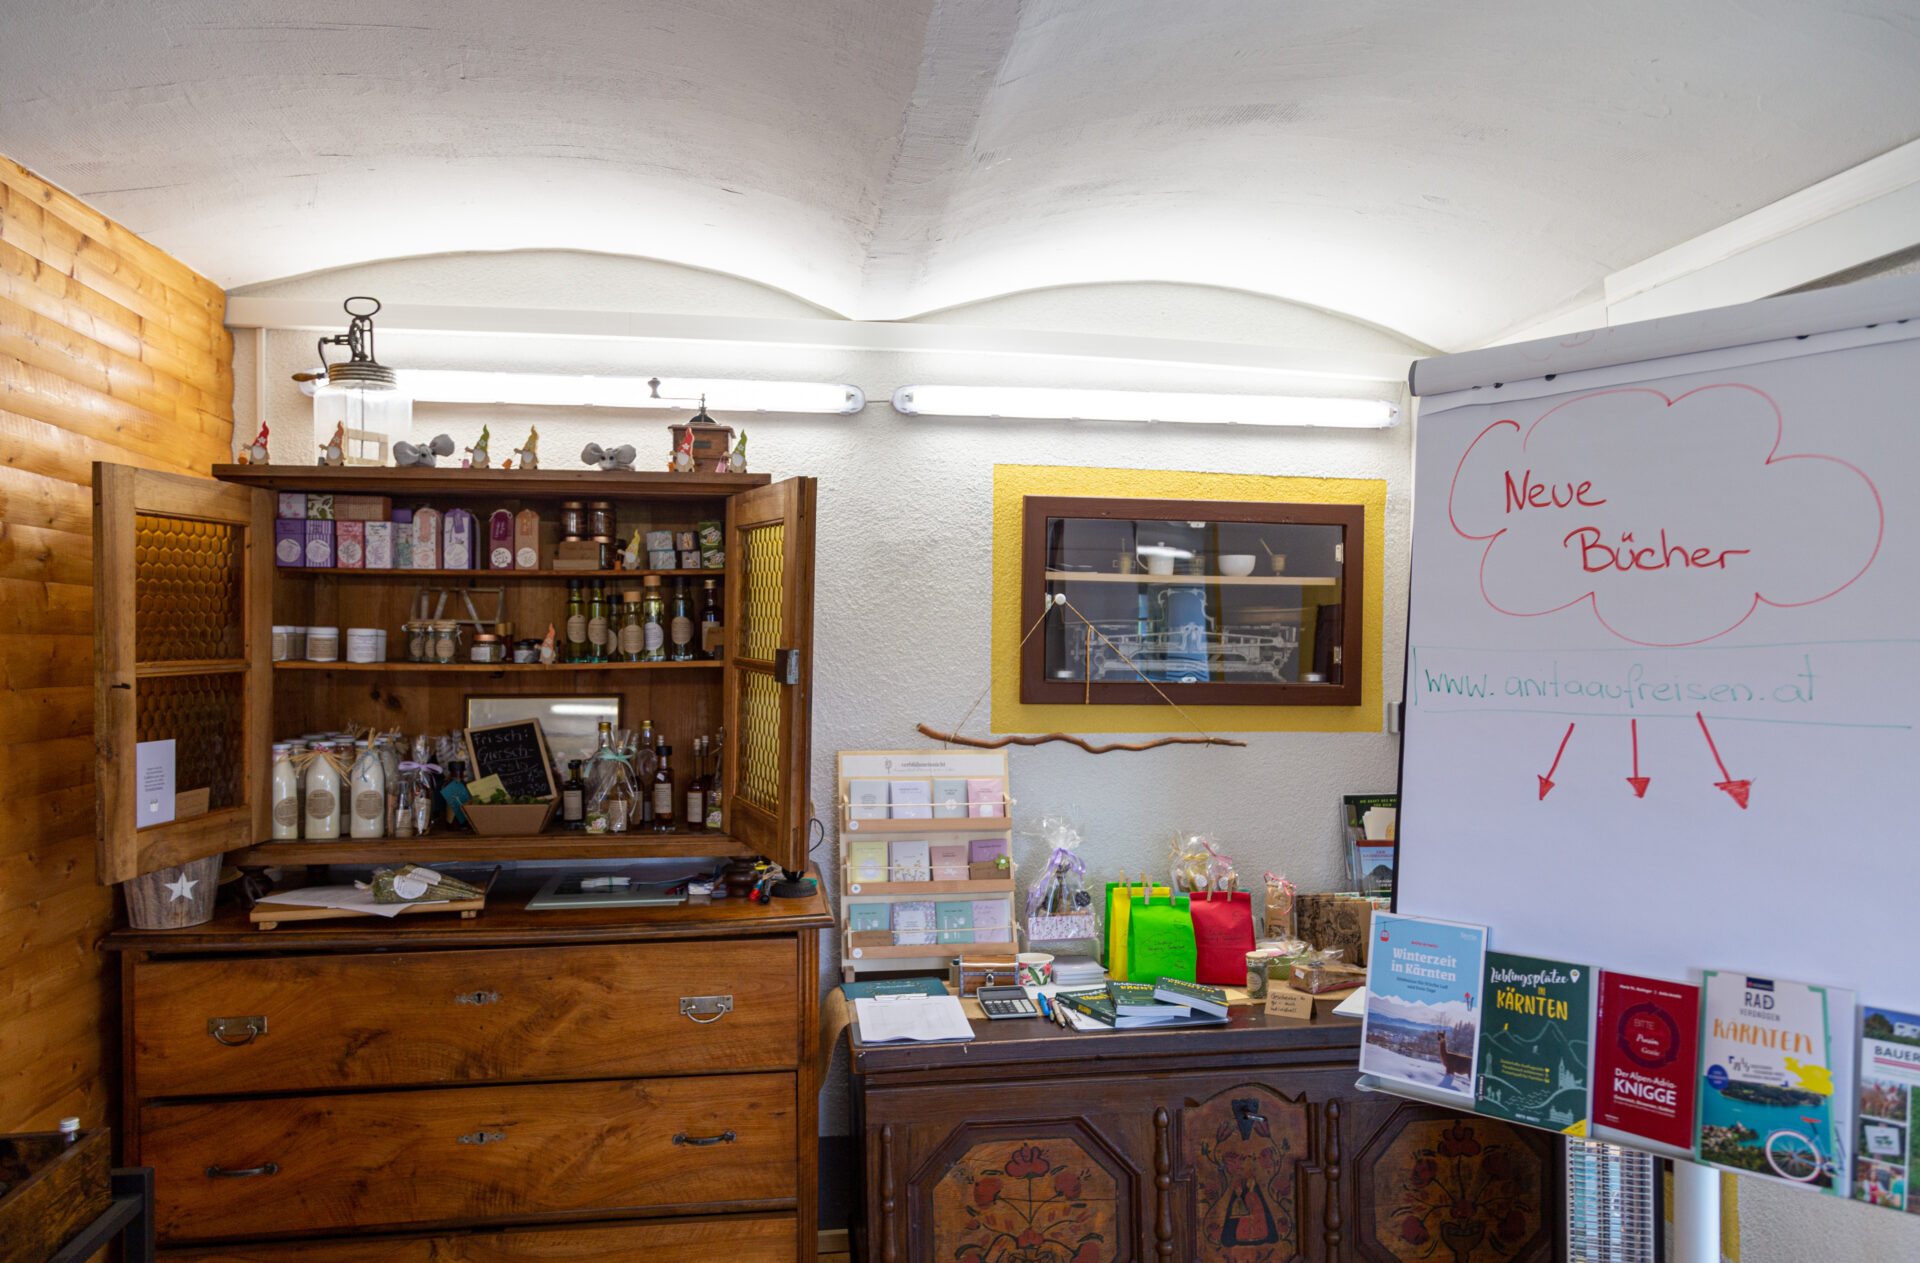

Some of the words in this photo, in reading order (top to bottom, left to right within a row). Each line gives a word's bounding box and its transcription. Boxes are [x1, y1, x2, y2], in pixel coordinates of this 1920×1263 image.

[1505, 470, 1606, 513] Neue
[1564, 527, 1750, 572] Bücher
[1425, 654, 1815, 709] www.anitaaufreisen.at
[1391, 959, 1403, 973] in
[1405, 963, 1456, 982] Kärnten
[1393, 947, 1457, 968] Winterzeit
[1490, 966, 1569, 988] Lieblingsplätze
[1496, 986, 1568, 1021] KÄRNTEN
[1745, 991, 1775, 1010] RAD
[1614, 1067, 1629, 1078] Der
[1613, 1077, 1678, 1106] KNIGGE
